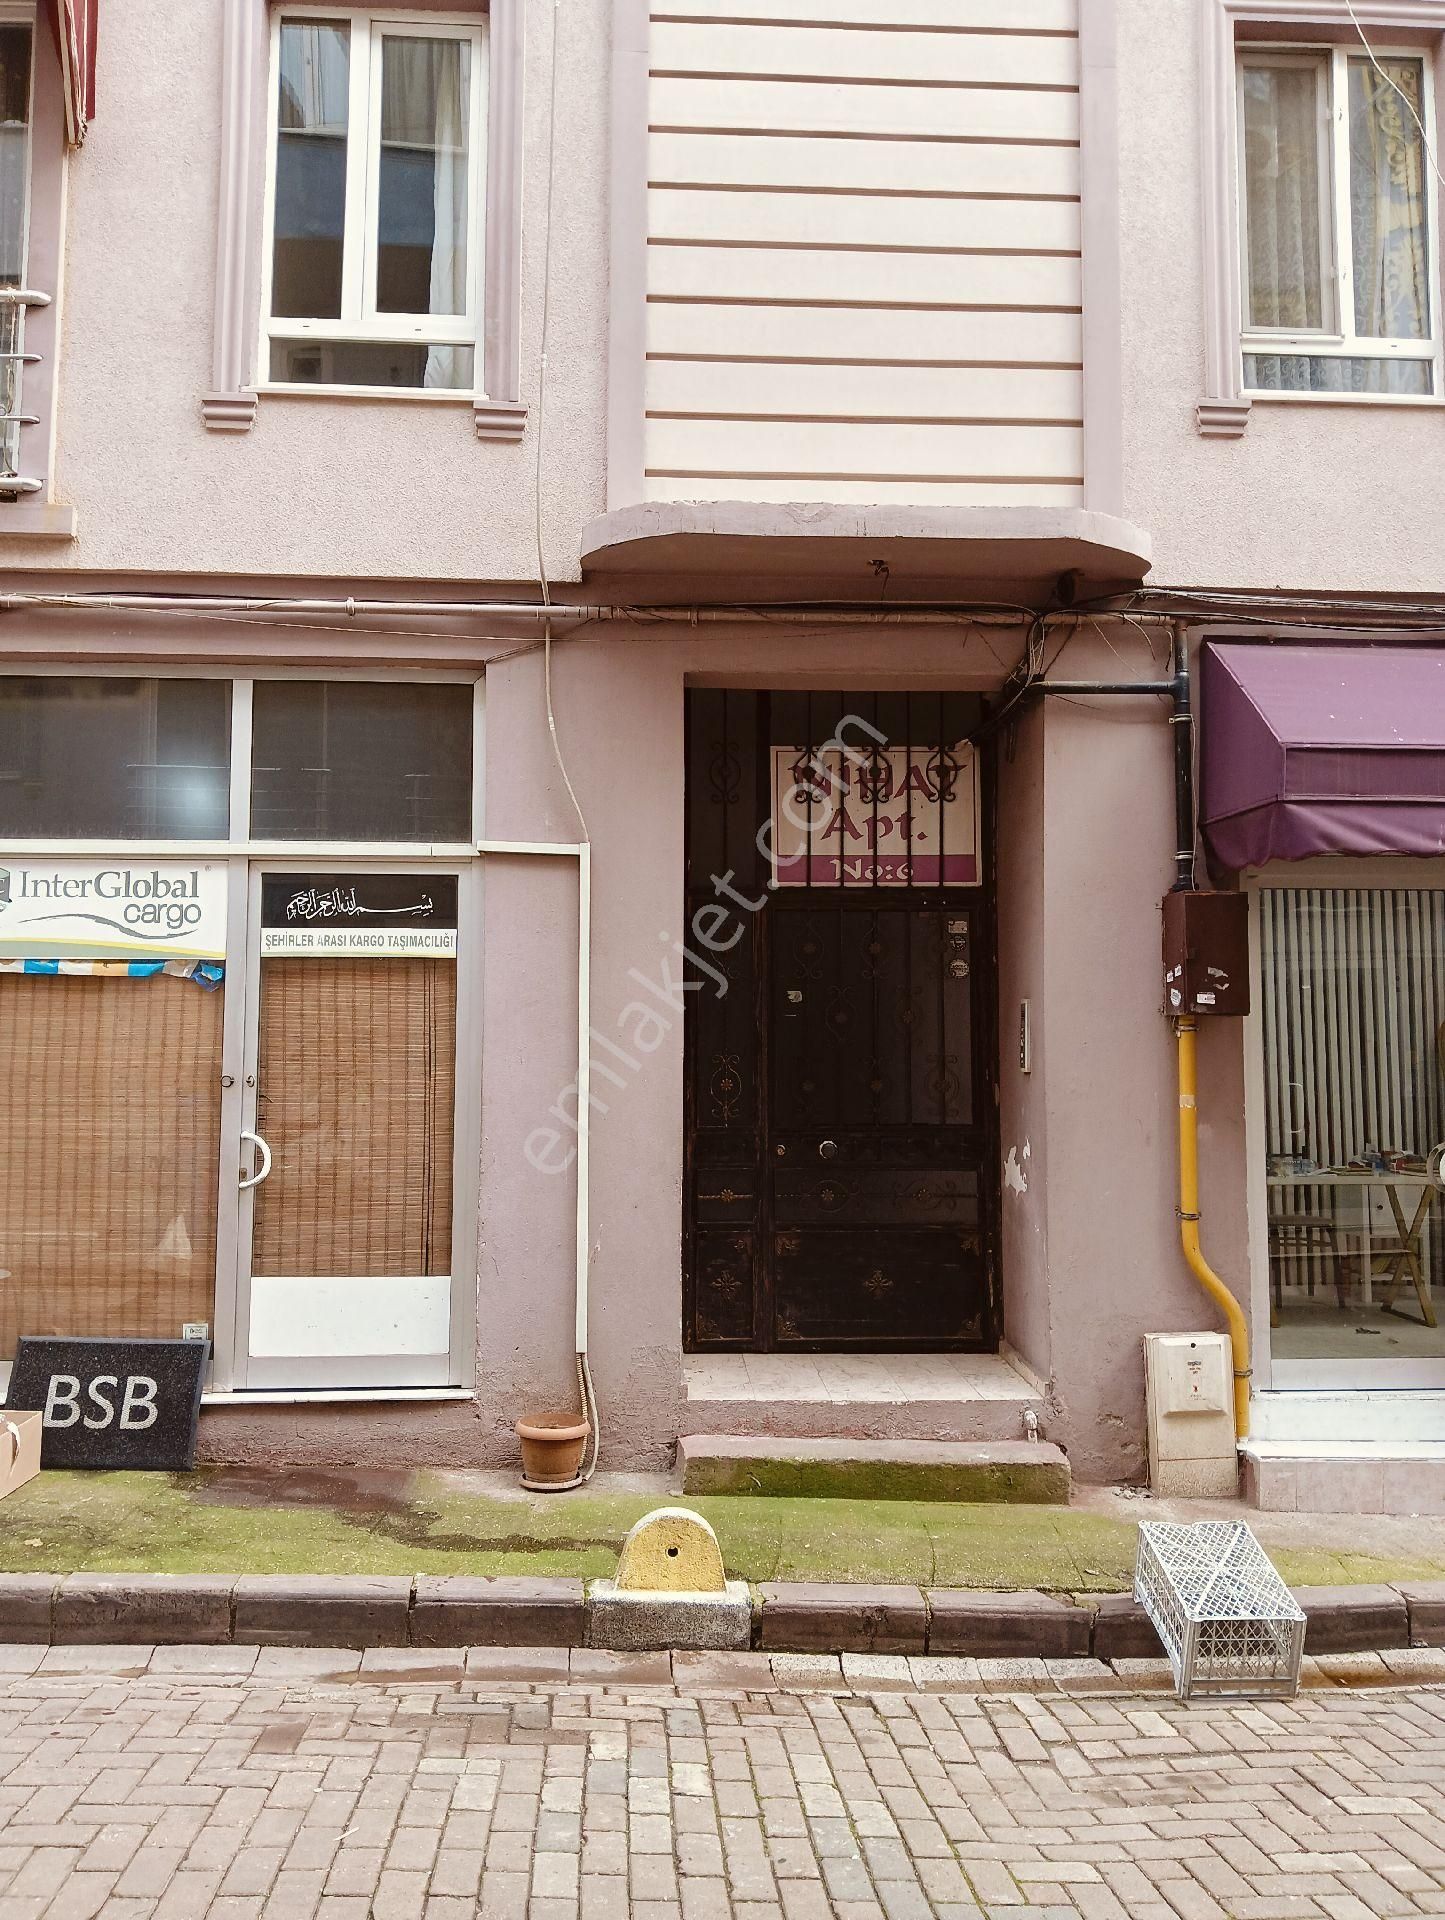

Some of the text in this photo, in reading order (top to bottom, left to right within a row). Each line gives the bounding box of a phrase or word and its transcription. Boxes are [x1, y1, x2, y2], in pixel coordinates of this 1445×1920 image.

[820, 807, 928, 850] Apt.
[830, 858, 914, 880] No:6
[18, 870, 200, 898] InterGlobal
[123, 903, 202, 929] cargo
[265, 931, 453, 950] ŞEHİRLER ARASI KARGO TAŞIMACILIĞI
[43, 1375, 159, 1430] BSB
